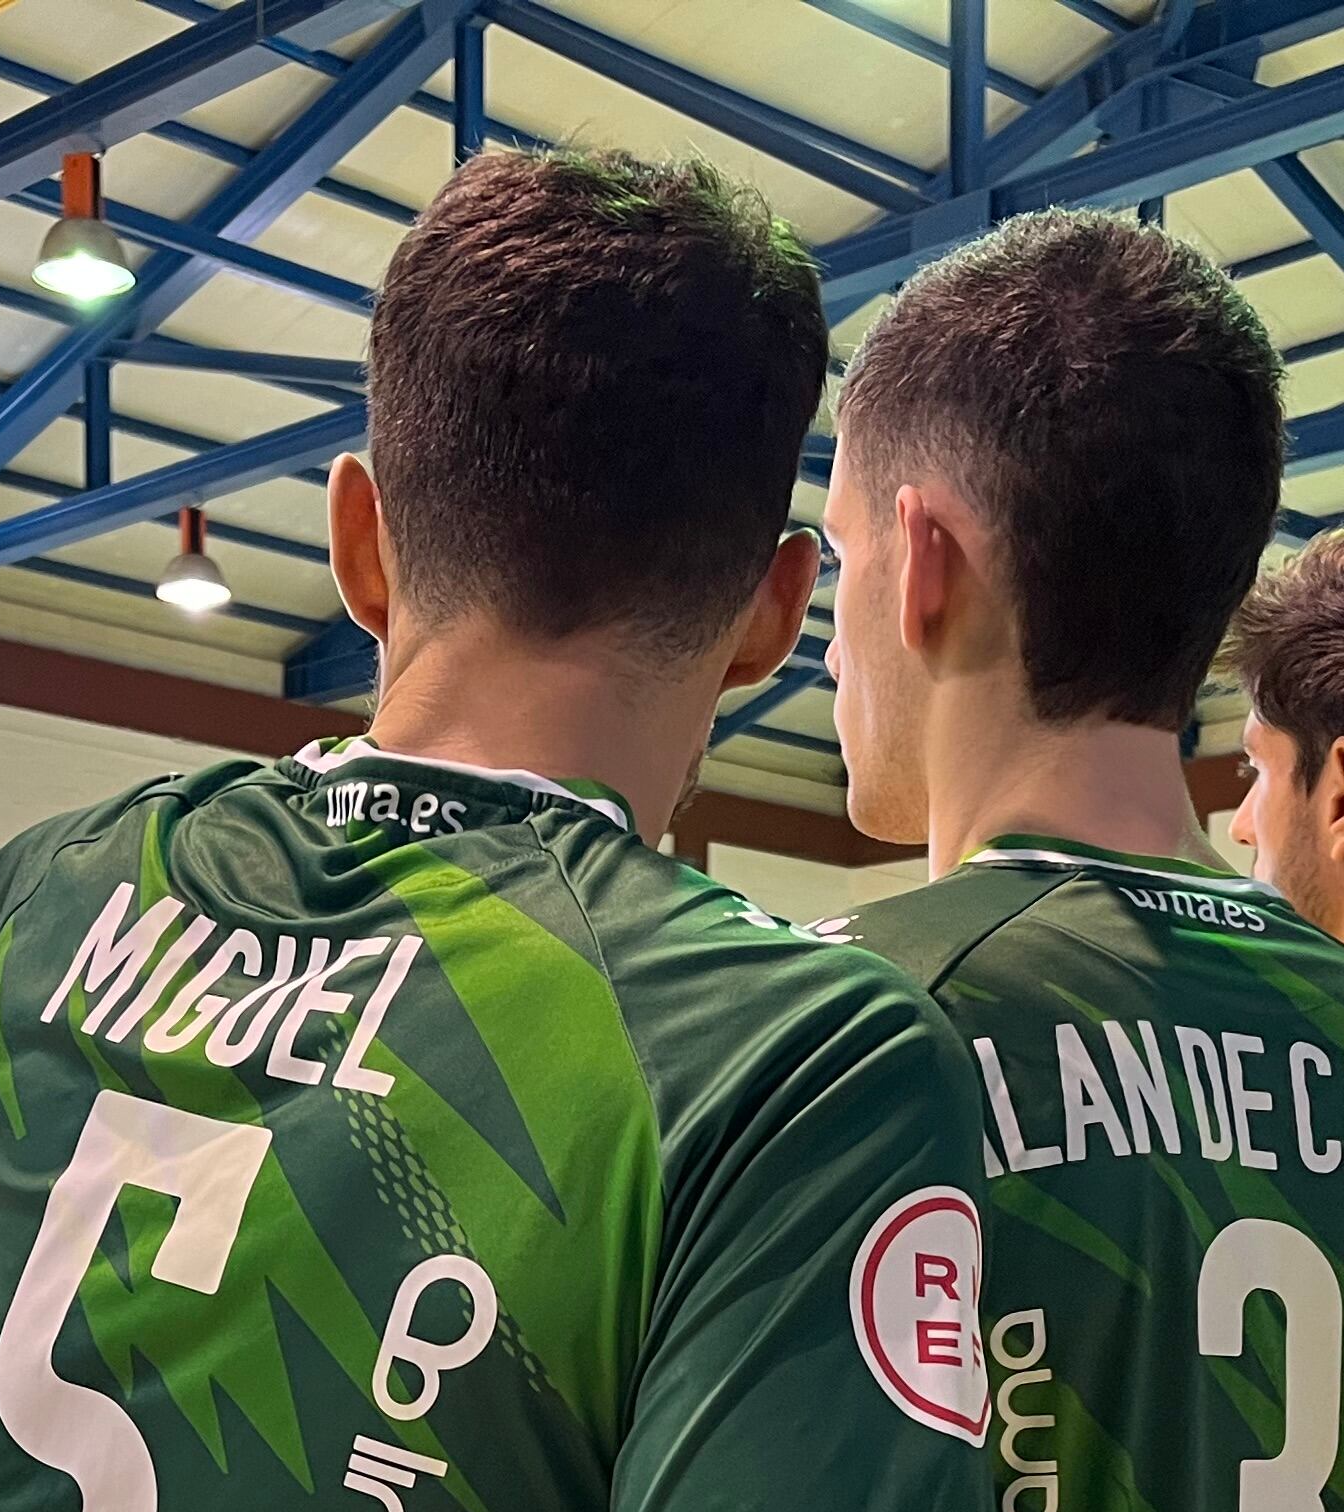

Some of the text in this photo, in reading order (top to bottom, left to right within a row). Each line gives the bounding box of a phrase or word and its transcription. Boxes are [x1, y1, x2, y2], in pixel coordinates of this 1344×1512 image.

[1119, 886, 1266, 932] uma.es
[39, 881, 424, 1098] MIGUEL
[973, 1020, 1182, 1178] LAN
[1174, 1025, 1278, 1172] DE
